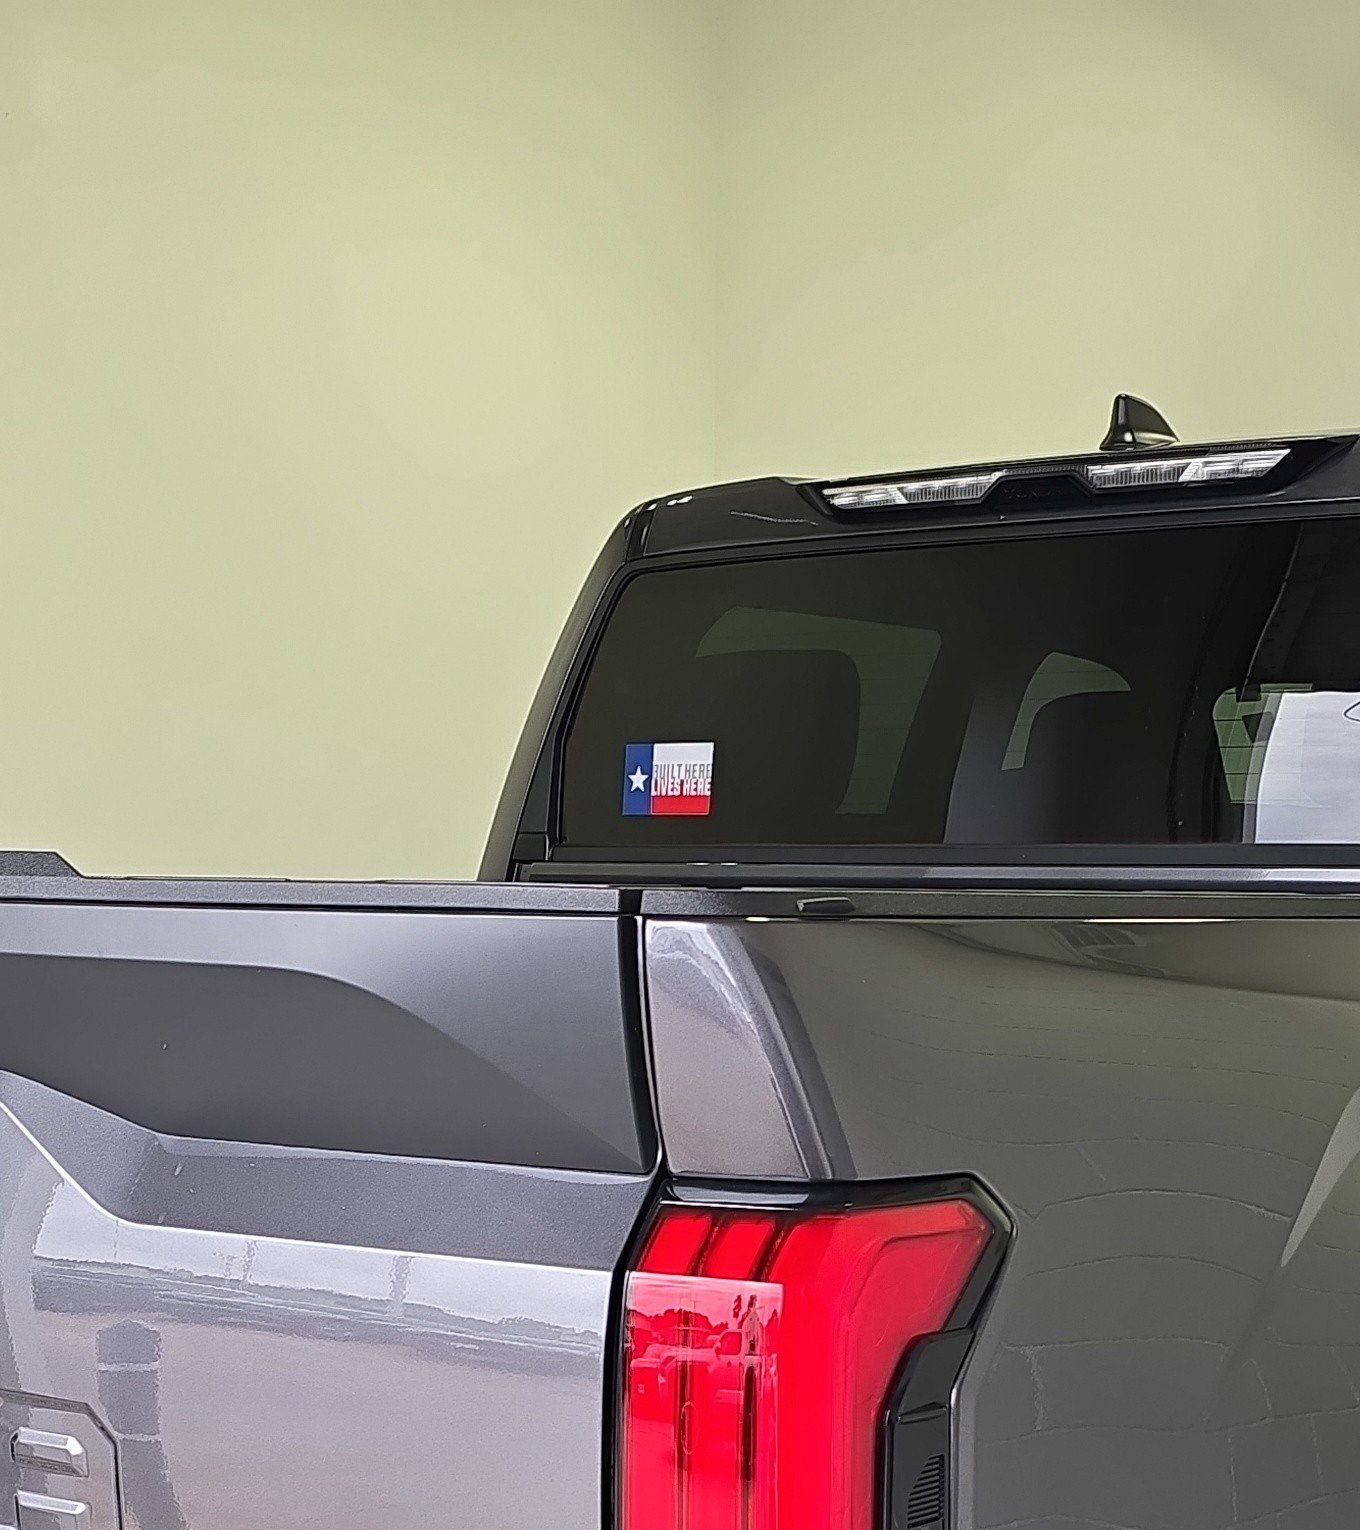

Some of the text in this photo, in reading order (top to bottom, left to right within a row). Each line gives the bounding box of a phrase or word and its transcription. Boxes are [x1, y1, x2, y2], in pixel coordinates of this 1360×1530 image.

[653, 763, 711, 780] BUILT HERE
[651, 779, 712, 797] LIVES HERE
